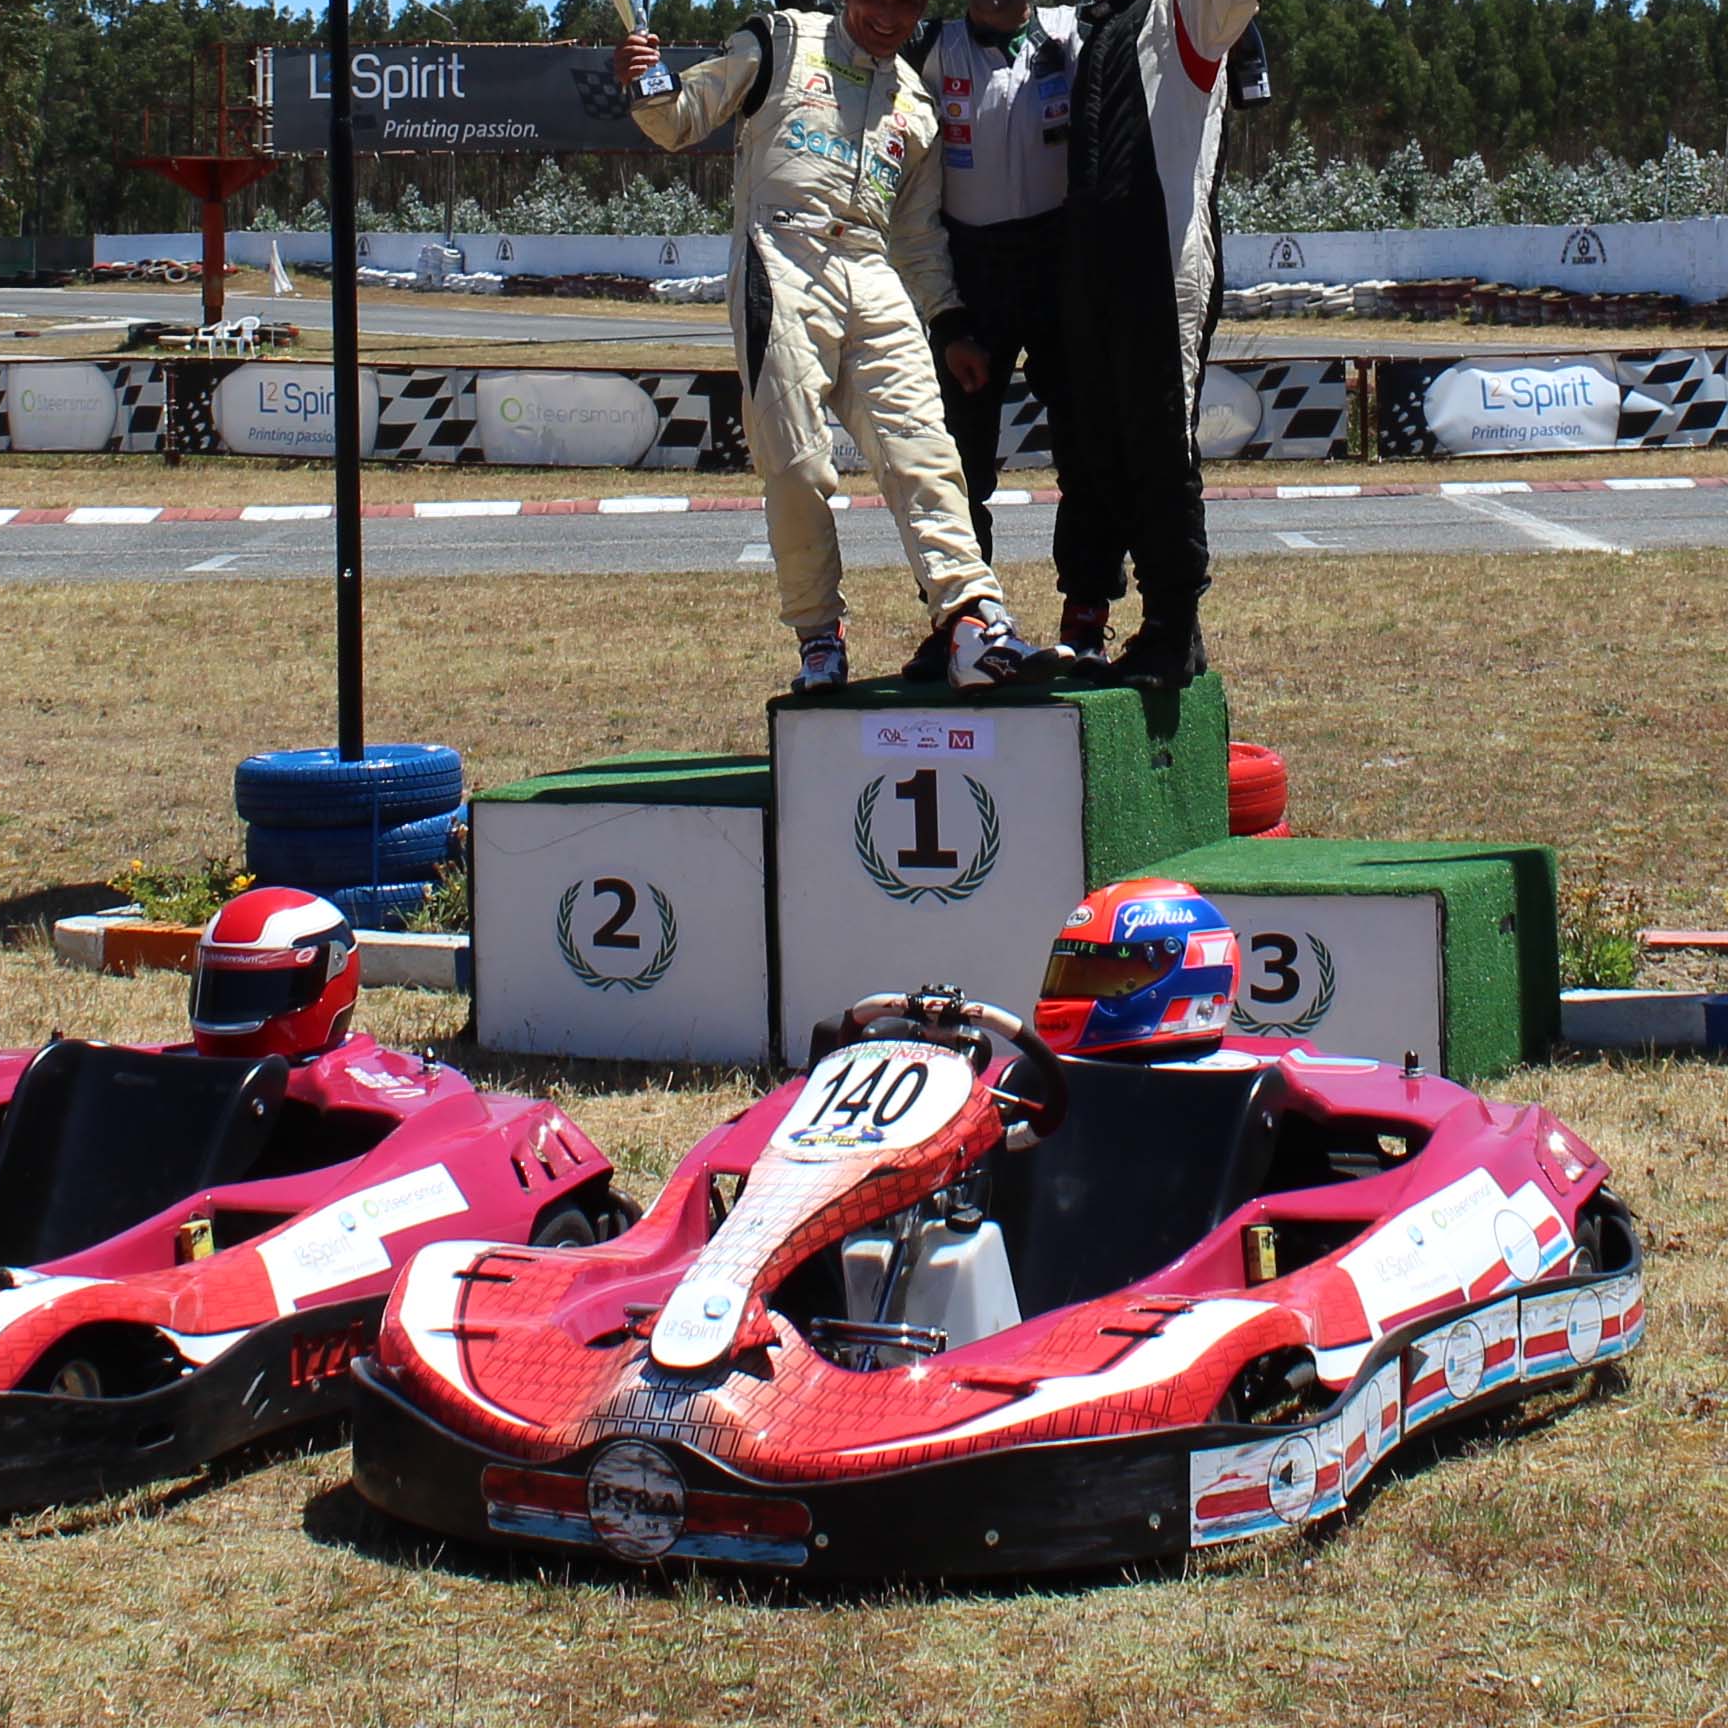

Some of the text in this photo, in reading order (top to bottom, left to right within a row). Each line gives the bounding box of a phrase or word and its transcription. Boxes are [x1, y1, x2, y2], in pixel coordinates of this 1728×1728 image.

[351, 52, 466, 110] Spirit
[383, 119, 540, 143] Printing passion.
[283, 381, 335, 422] Spir
[524, 402, 635, 423] Steersman
[1510, 374, 1593, 416] Spirit
[247, 427, 336, 446] Printing passio
[1471, 422, 1585, 441] Printing passion.
[895, 768, 959, 870] 1
[592, 878, 640, 950] 2
[1250, 933, 1300, 1005] 3
[809, 1059, 929, 1128] 140
